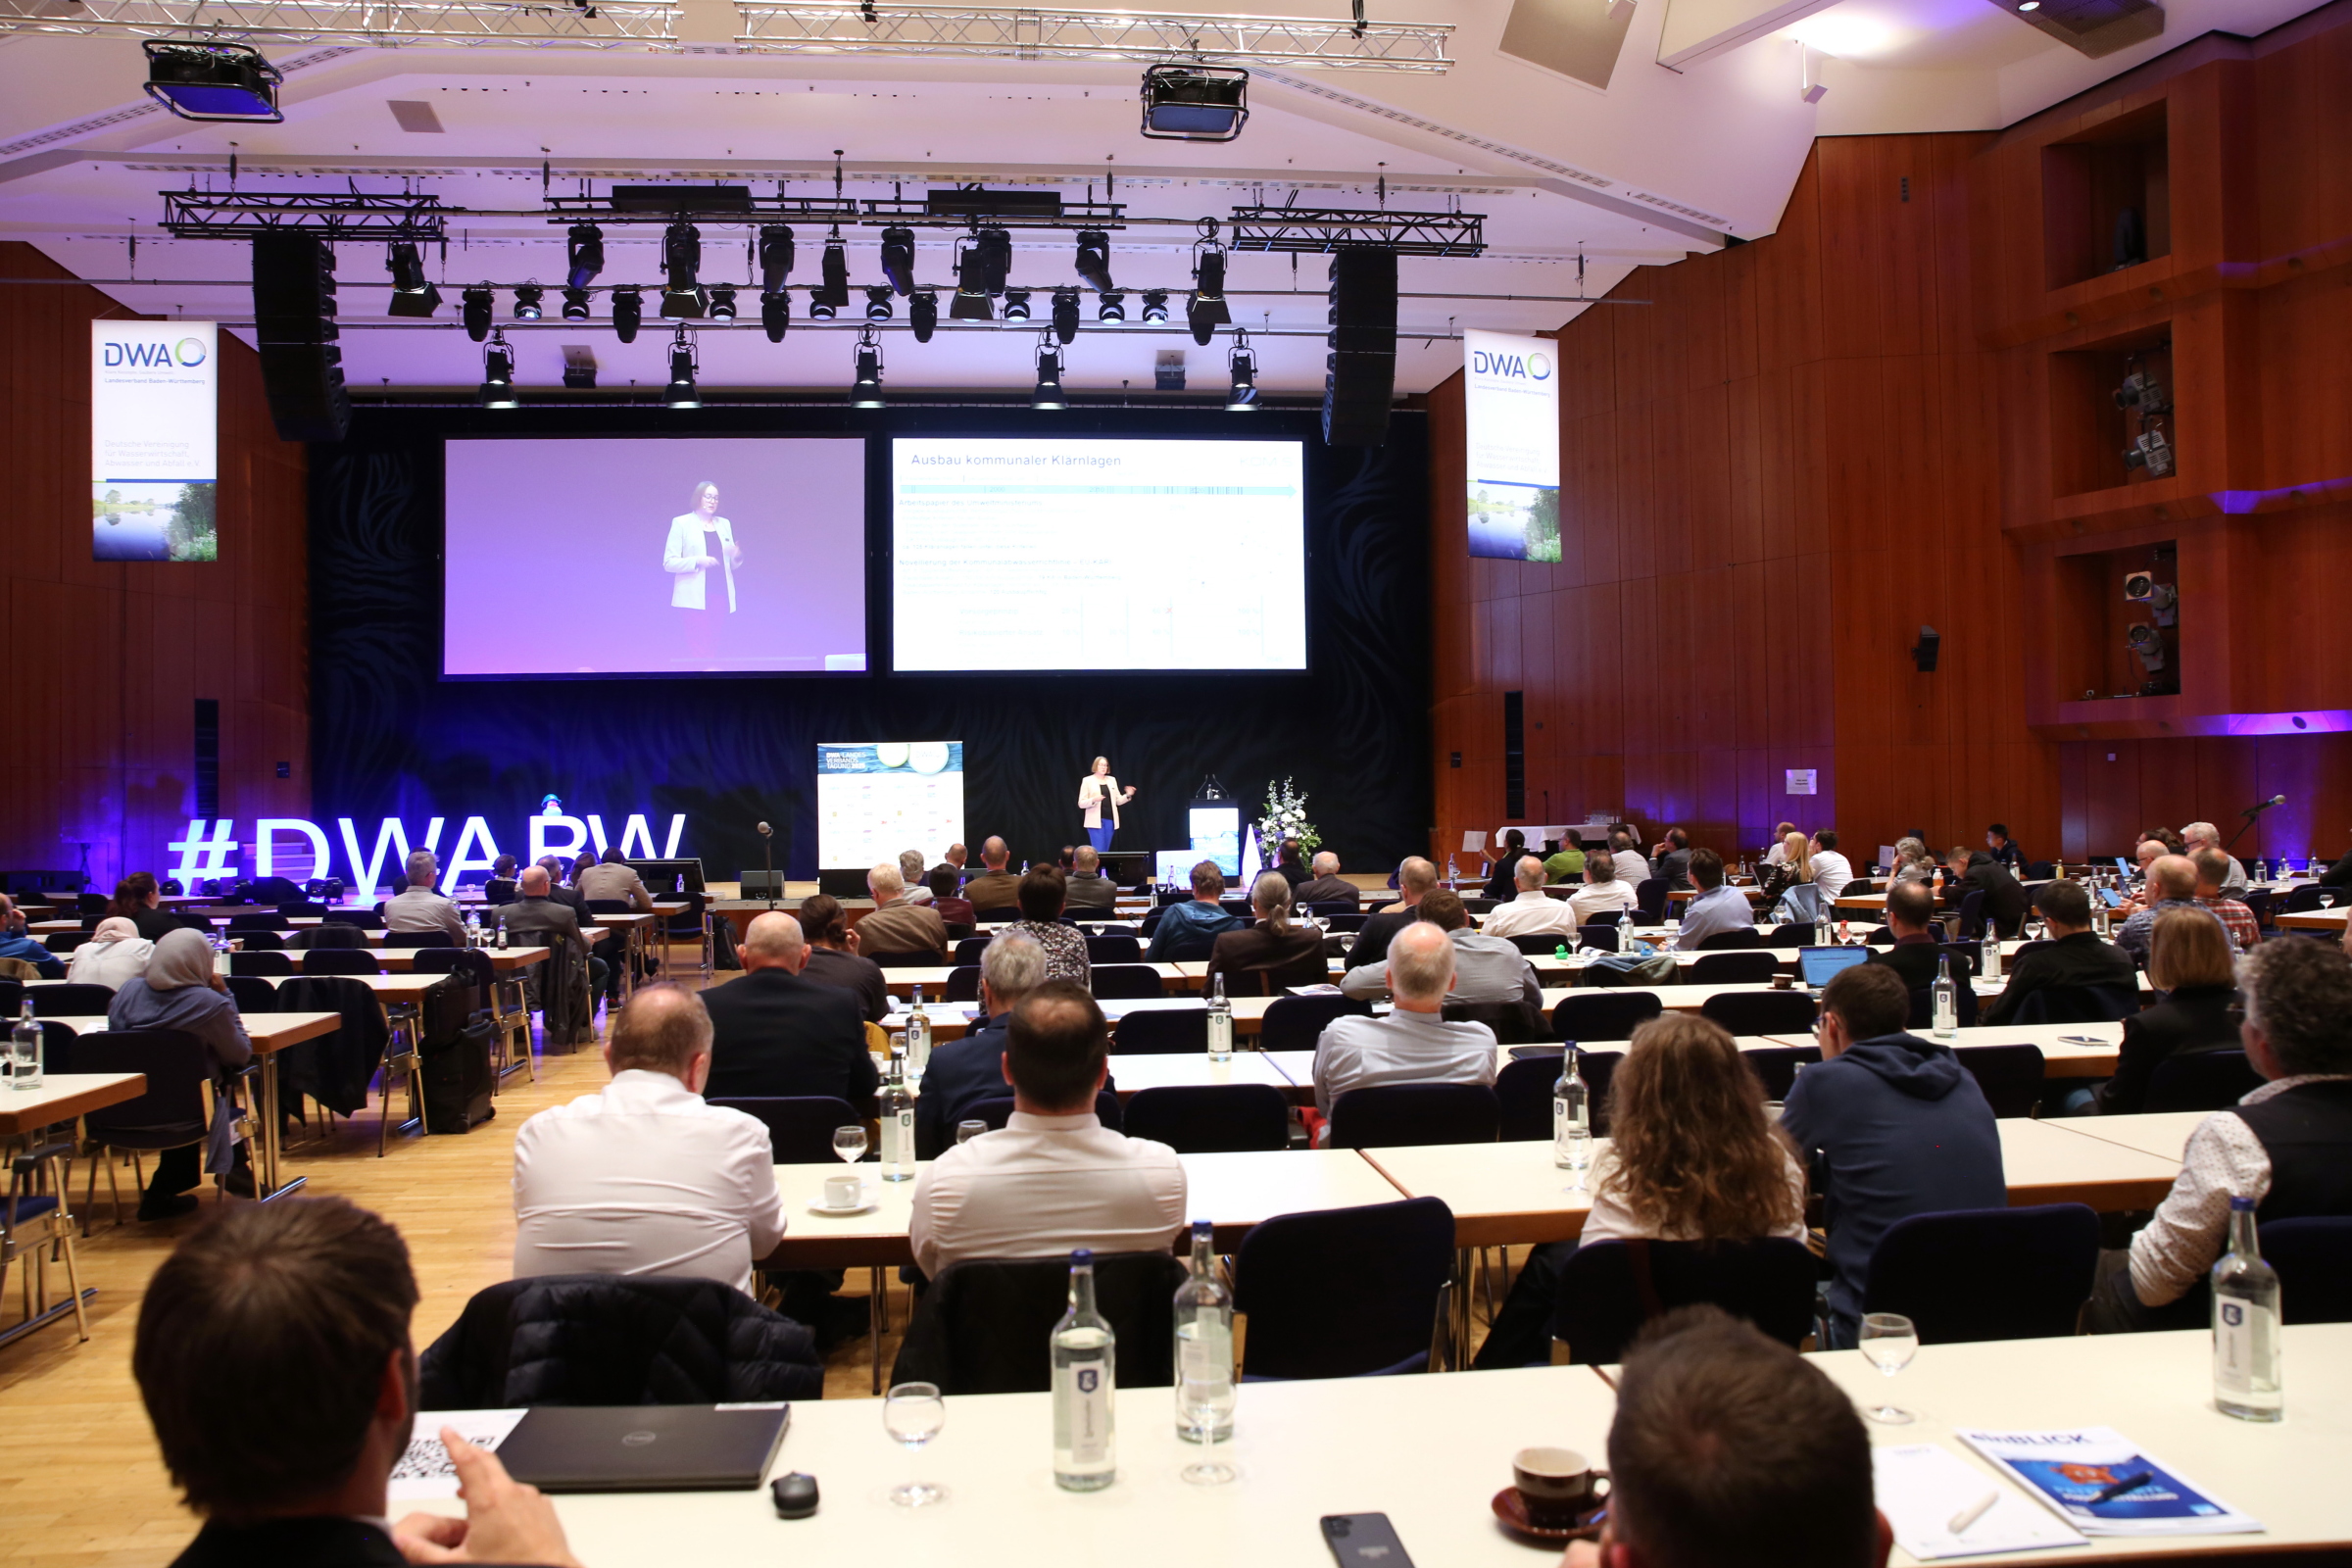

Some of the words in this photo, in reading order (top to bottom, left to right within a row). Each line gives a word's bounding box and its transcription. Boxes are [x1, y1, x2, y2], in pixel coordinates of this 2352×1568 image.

[104, 342, 173, 368] DWA
[1473, 350, 1527, 379] DWA
[143, 440, 189, 449] Vereinigung
[911, 455, 961, 466] Ausbau
[966, 455, 1047, 466] kommunaler
[1052, 455, 1121, 468] Klärnlagen
[899, 499, 949, 508] Arbeitspapier
[167, 812, 686, 896] #DWABW
